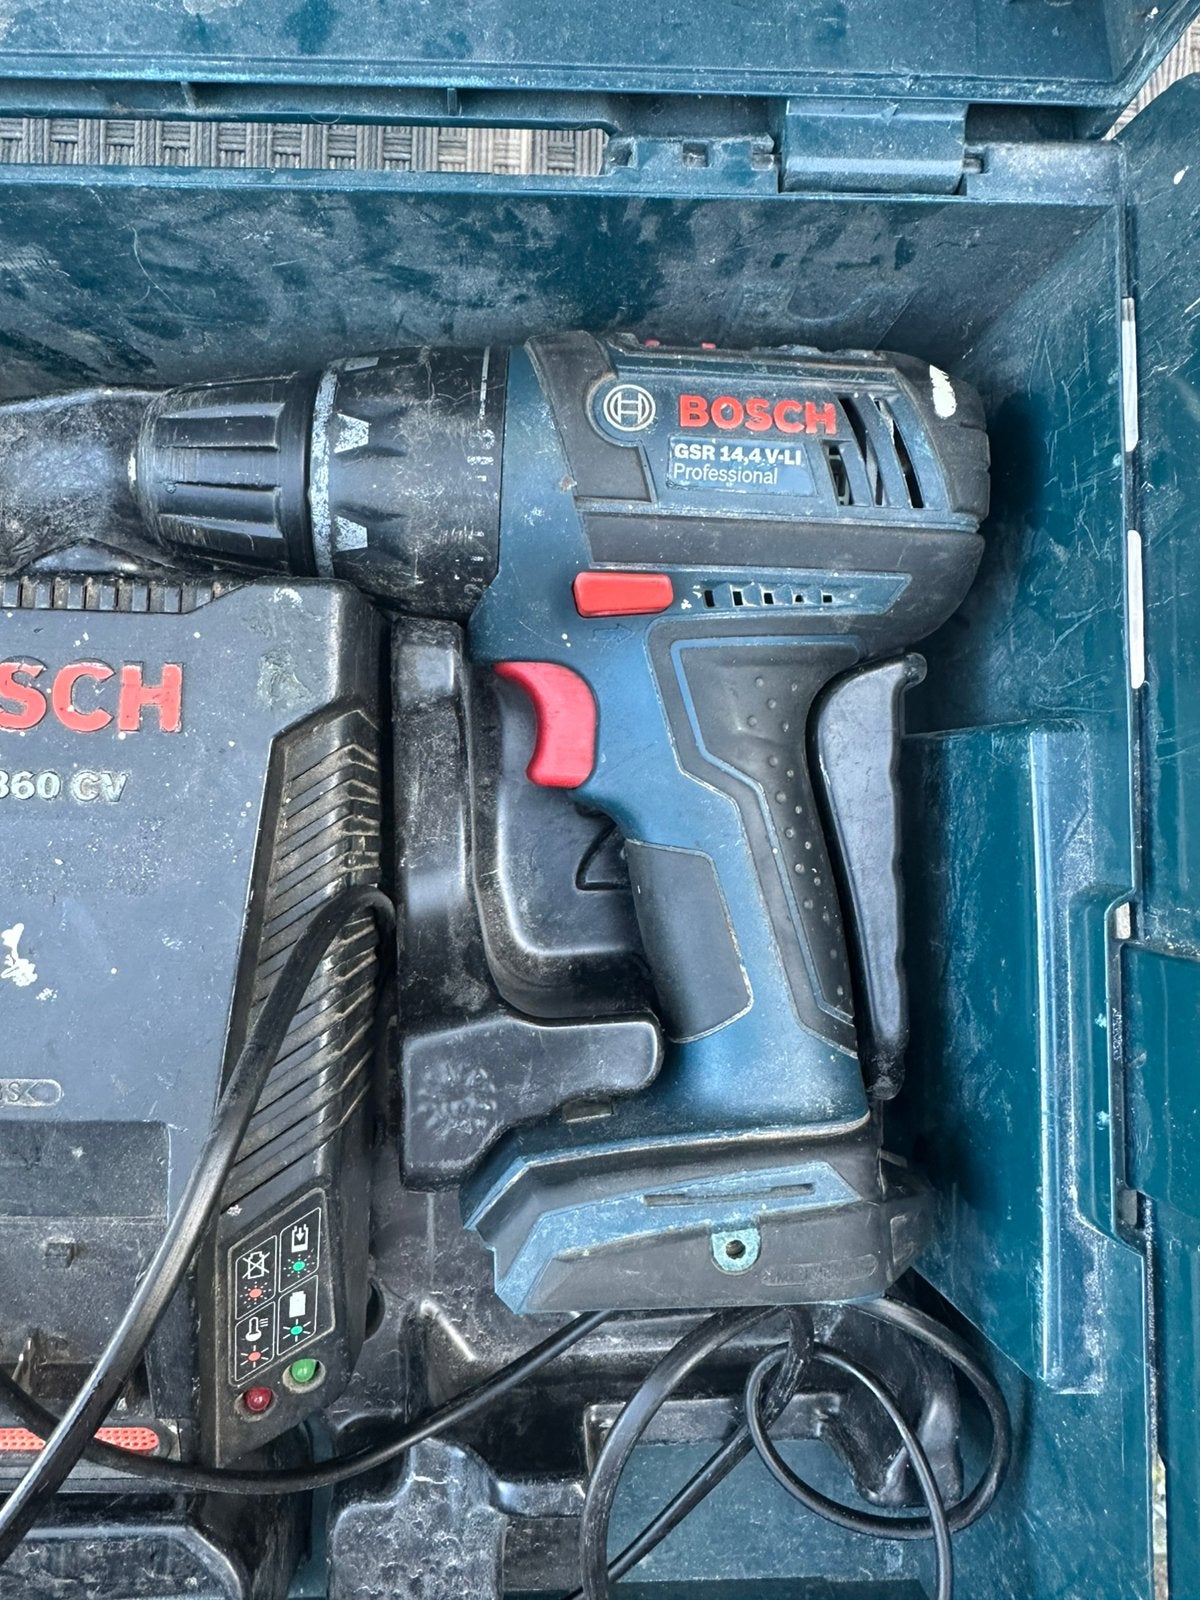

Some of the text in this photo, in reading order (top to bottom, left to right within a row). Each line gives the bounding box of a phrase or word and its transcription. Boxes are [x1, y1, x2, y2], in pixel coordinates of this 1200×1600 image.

[679, 394, 838, 435] BOSCH
[674, 443, 715, 461] GSR
[673, 463, 778, 485] Professional
[71, 770, 130, 803] CV
